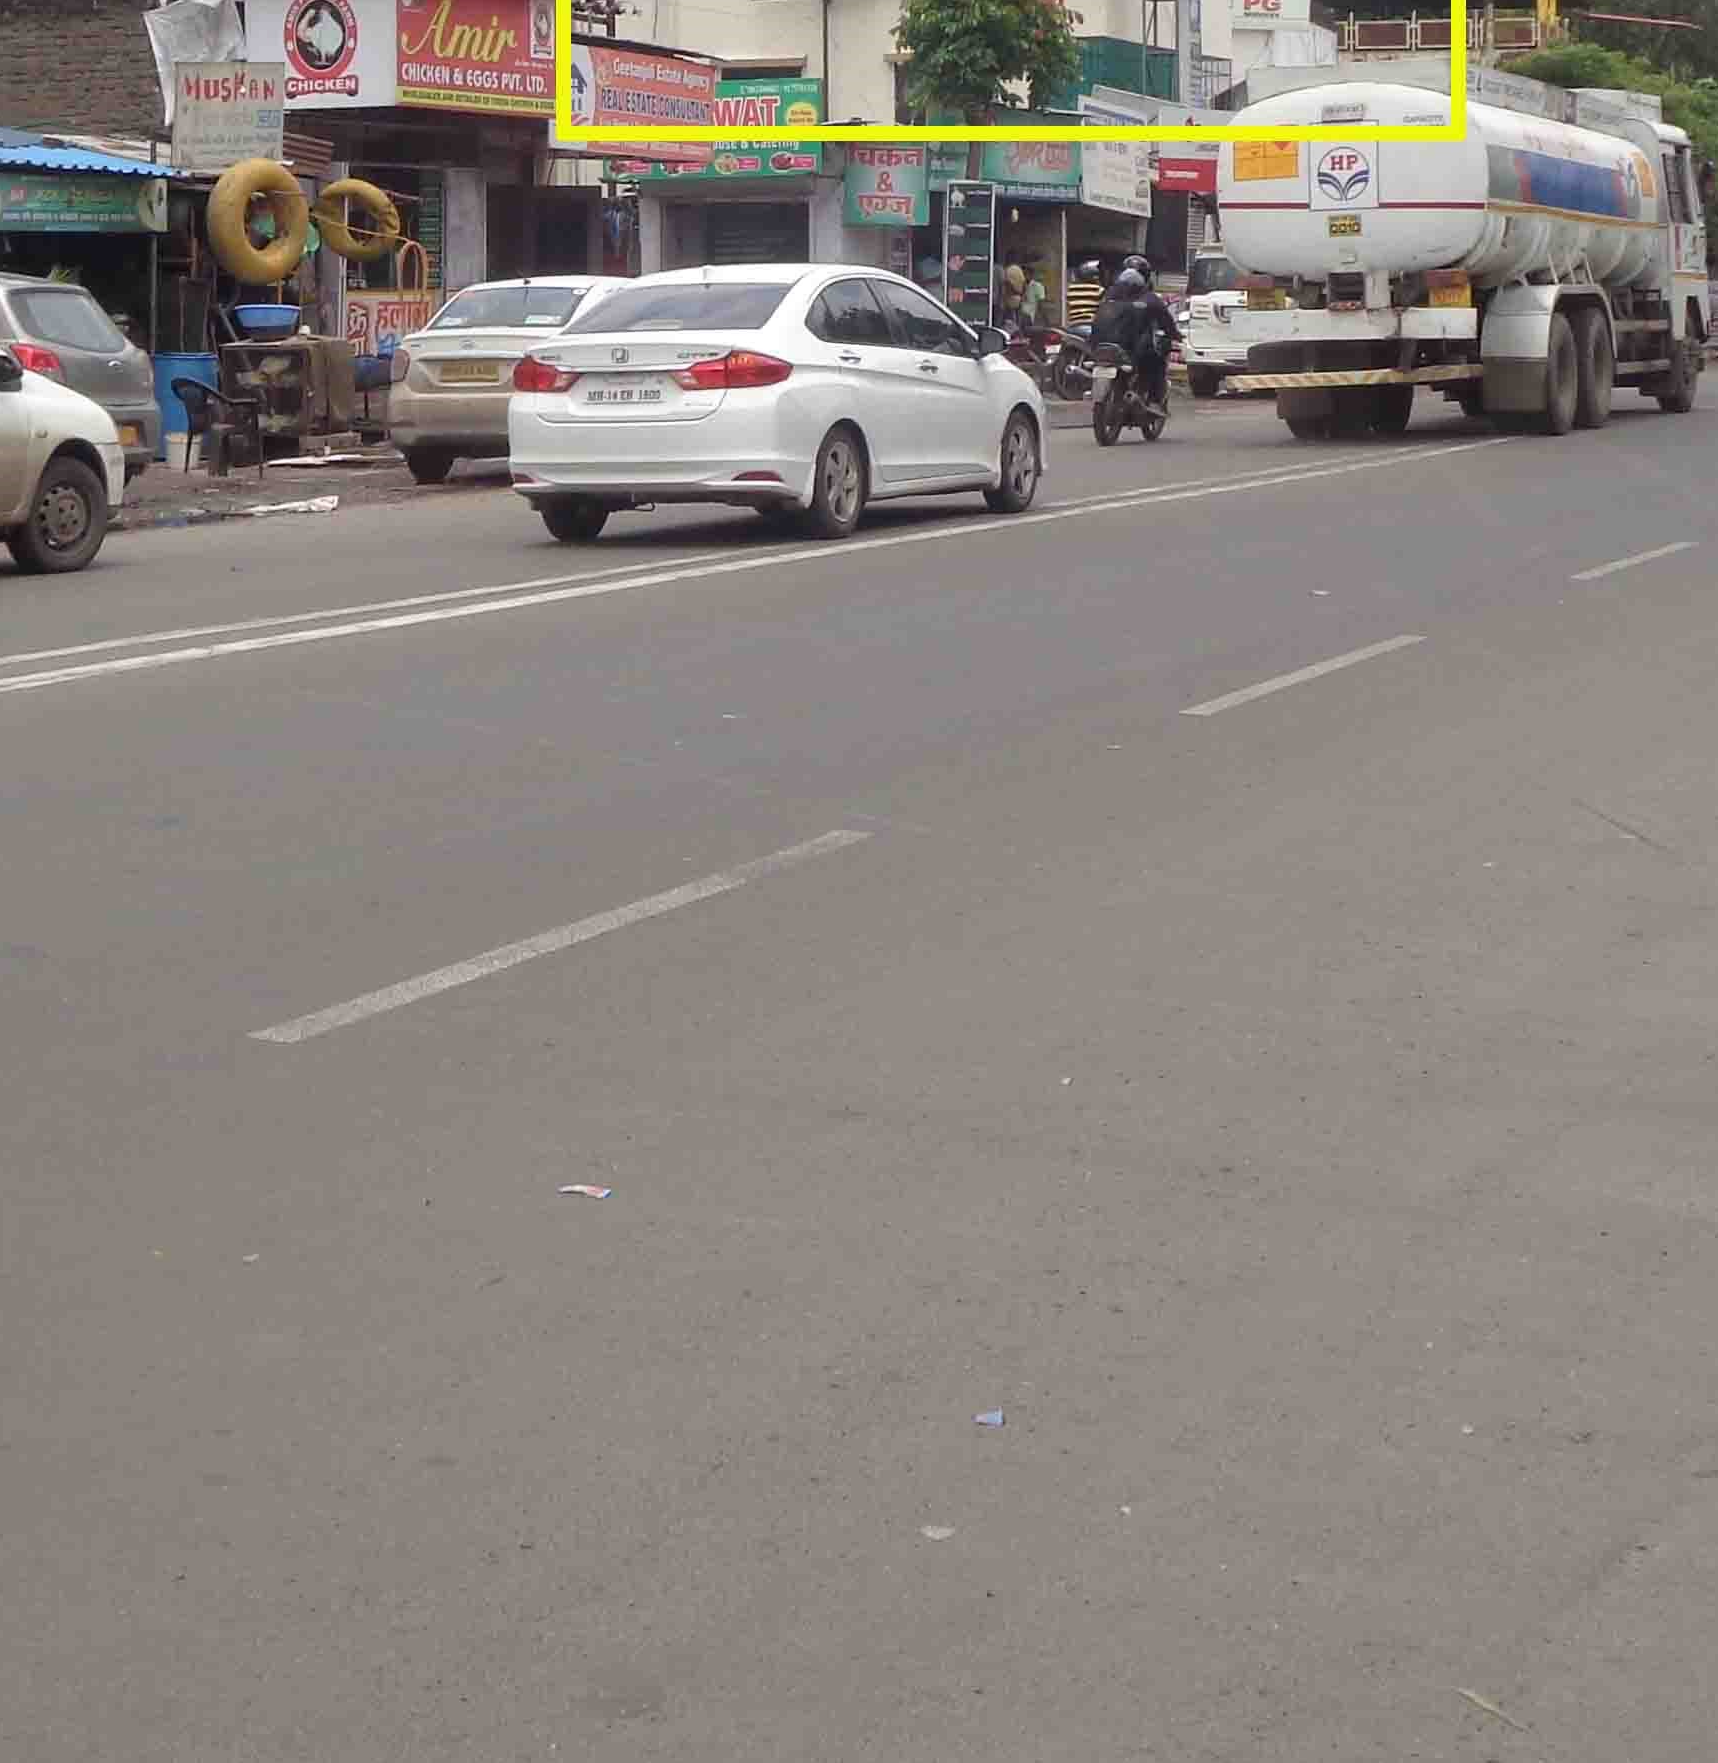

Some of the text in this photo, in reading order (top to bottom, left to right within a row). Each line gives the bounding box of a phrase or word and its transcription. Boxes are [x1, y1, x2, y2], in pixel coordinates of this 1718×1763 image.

[287, 78, 356, 92] CHICKEN
[401, 62, 548, 94] CHICKEN & EGGS PVT. LTD.
[601, 87, 711, 122] REAL ESTATE CONSULTANT
[1330, 154, 1359, 172] HP
[876, 171, 893, 192] &
